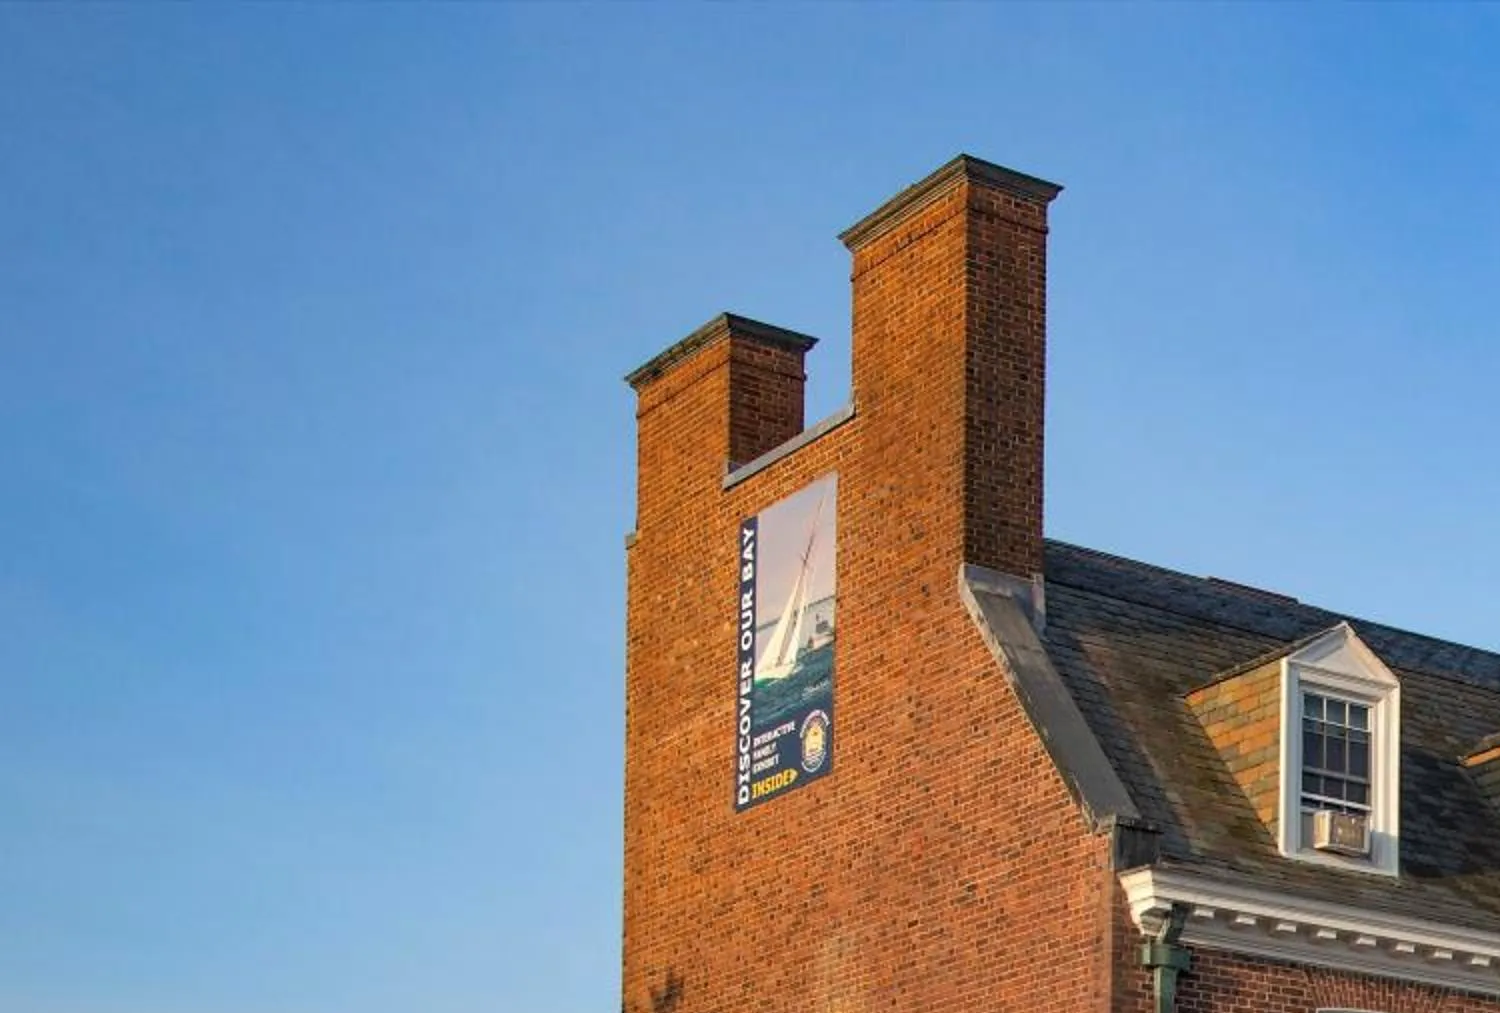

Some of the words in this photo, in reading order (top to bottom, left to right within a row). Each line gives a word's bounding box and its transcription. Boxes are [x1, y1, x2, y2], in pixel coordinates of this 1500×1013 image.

[742, 527, 756, 584] BAY
[741, 590, 755, 651] OUR
[738, 657, 754, 806] DISCOVER
[751, 770, 791, 799] INSIDE
